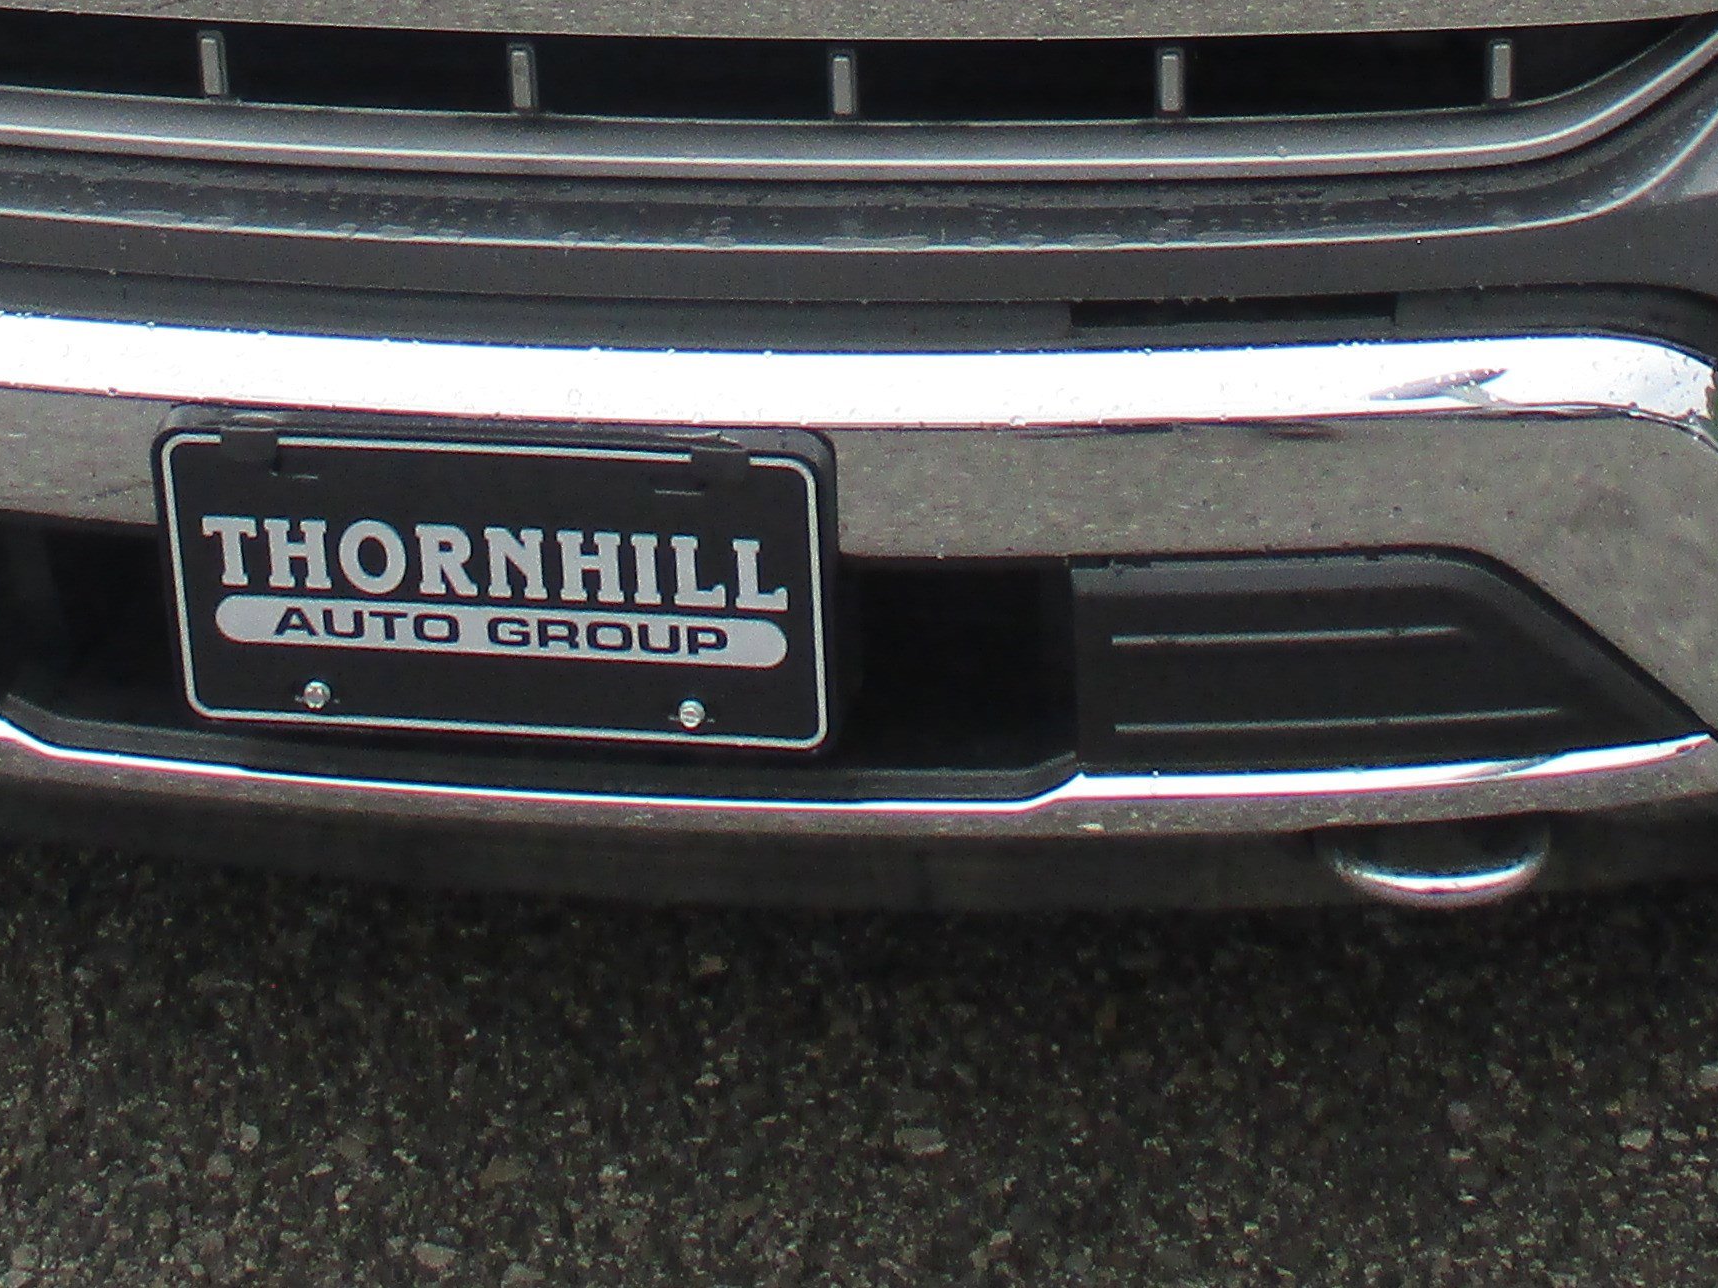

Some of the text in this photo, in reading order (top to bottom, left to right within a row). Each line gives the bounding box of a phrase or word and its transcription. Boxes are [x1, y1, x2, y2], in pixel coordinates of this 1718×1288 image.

[201, 515, 789, 612] THORNHILL
[274, 607, 729, 656] AUTO GROUP
